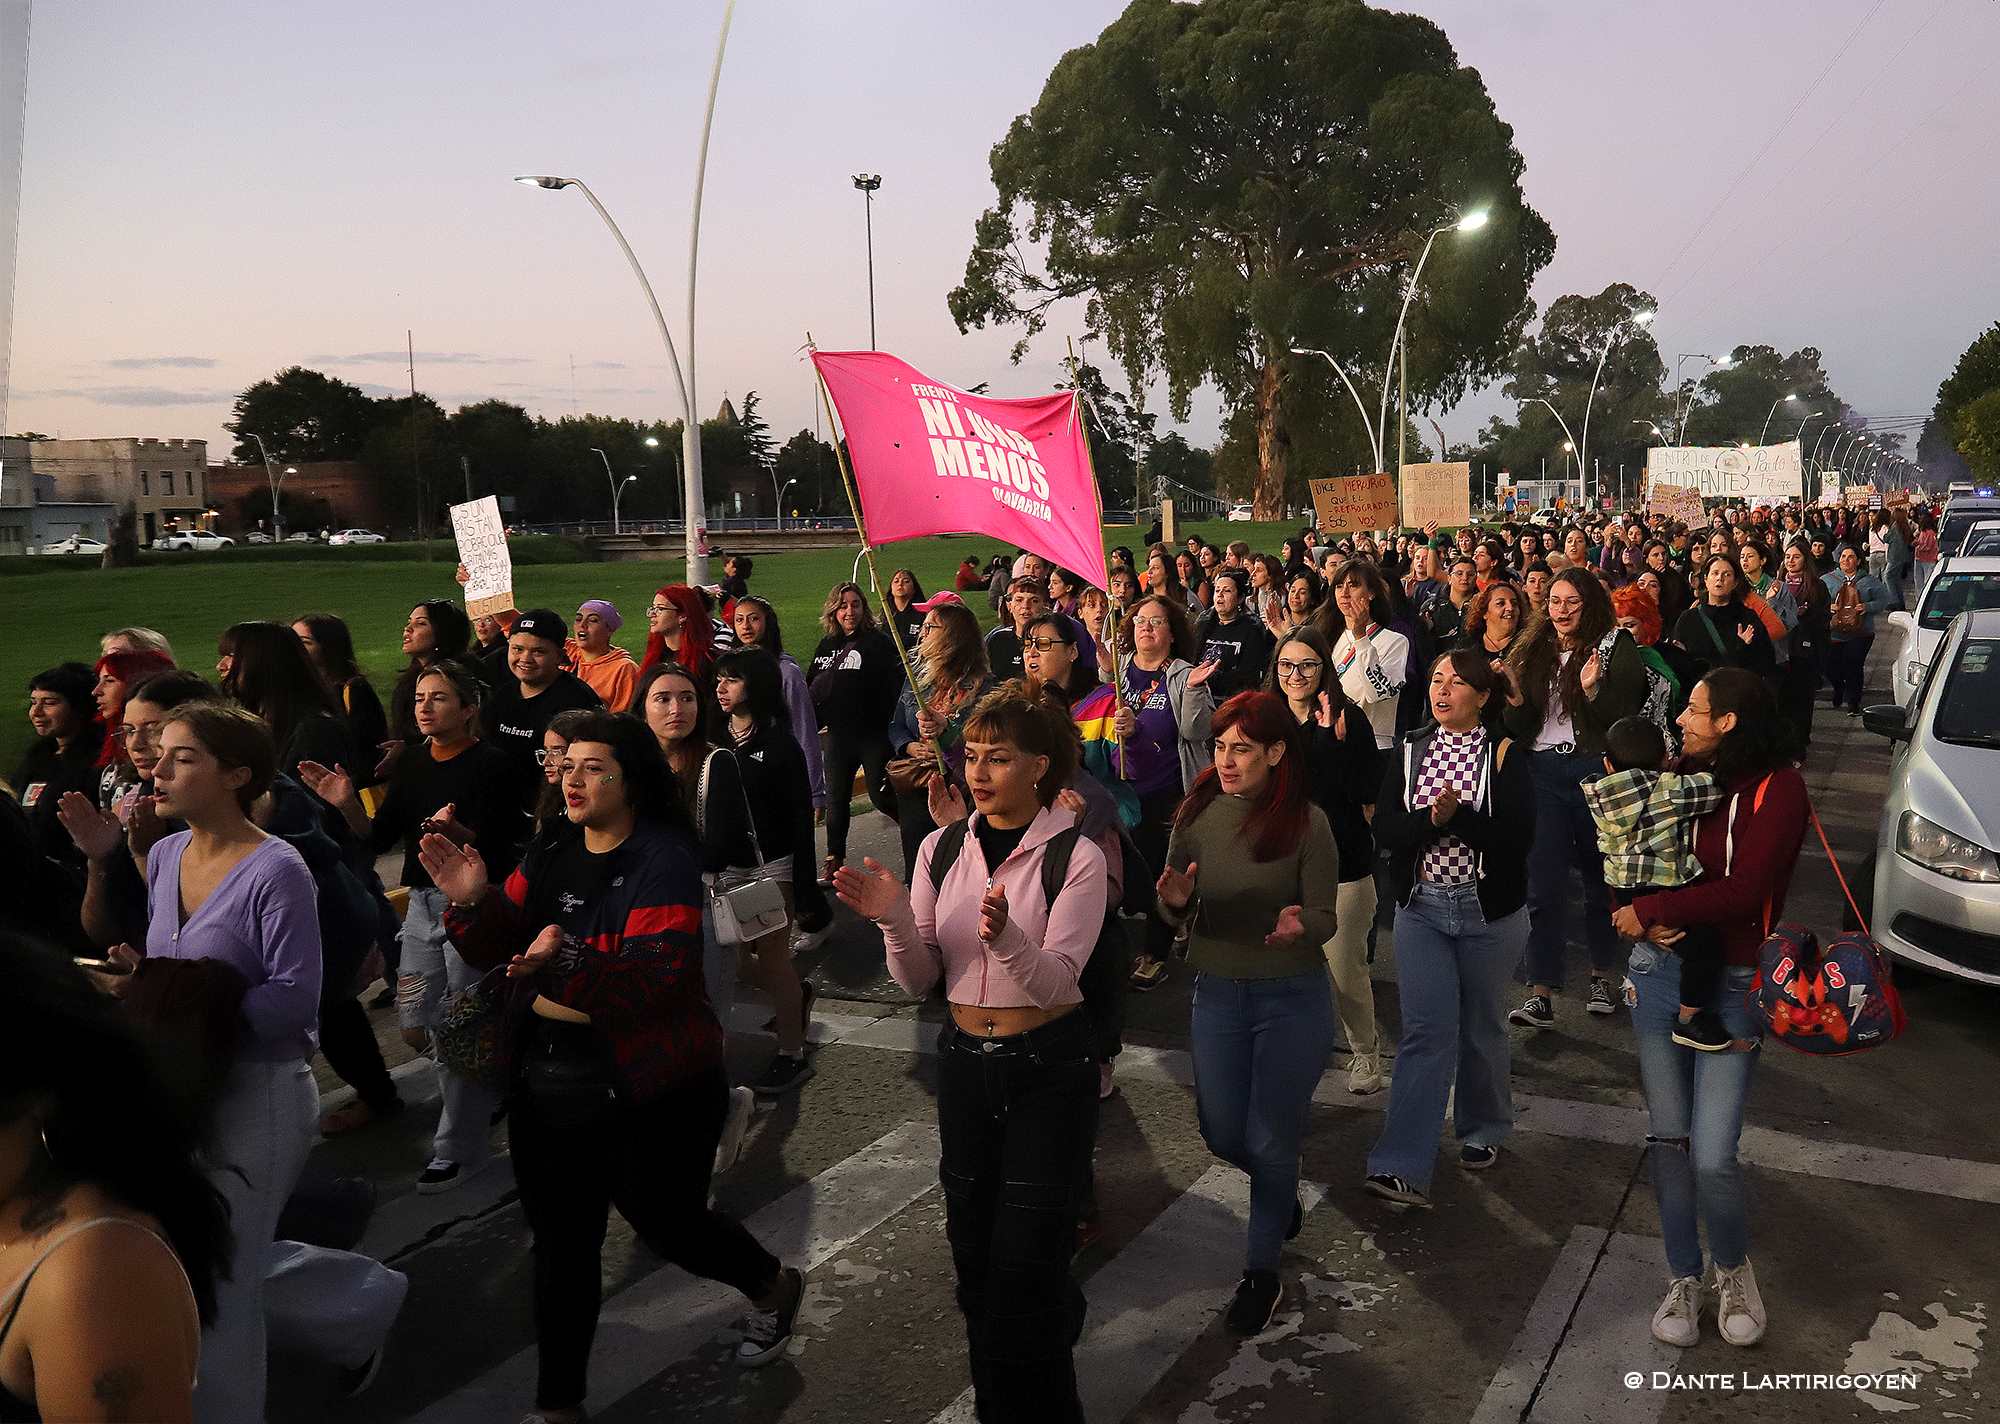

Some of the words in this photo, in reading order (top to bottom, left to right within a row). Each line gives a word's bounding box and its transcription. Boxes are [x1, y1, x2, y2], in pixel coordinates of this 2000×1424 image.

[911, 383, 960, 403] FRENTE
[918, 398, 966, 438] NI
[964, 407, 1039, 461] UNA
[928, 438, 1050, 501] MENOS
[1315, 482, 1336, 495] DICE
[1358, 515, 1376, 528] VOS
